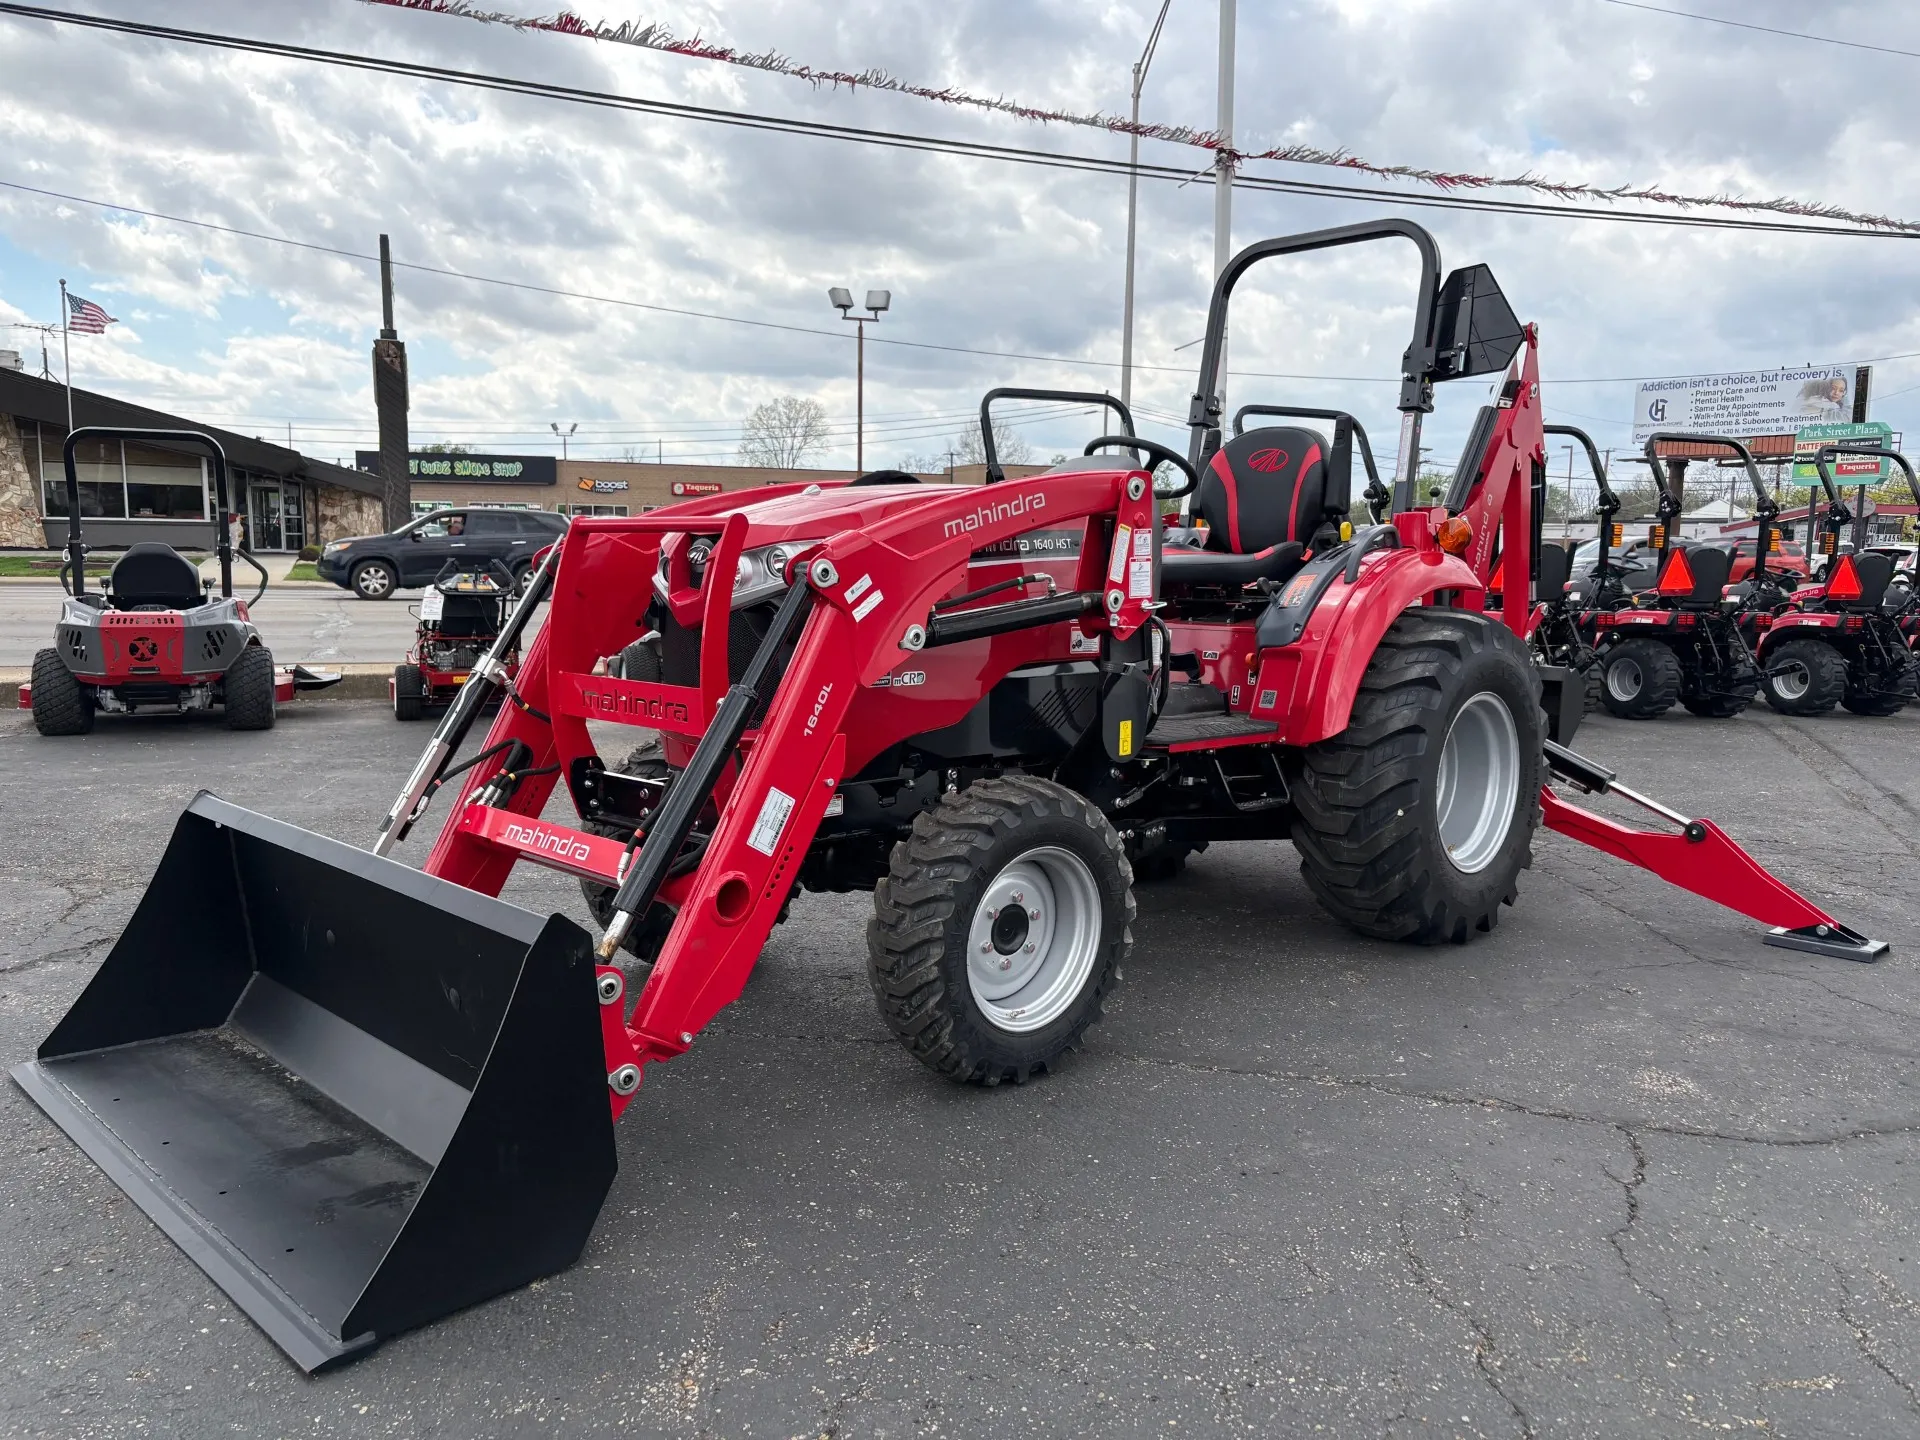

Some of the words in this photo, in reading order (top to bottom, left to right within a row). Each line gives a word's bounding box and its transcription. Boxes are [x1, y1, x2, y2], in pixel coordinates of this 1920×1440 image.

[1641, 380, 1687, 392] Addiction
[1689, 378, 1711, 388] isn't
[1721, 374, 1758, 385] choice,
[1761, 373, 1779, 383] but
[1781, 369, 1830, 381] recovery
[1832, 367, 1845, 377] is.
[1695, 389, 1724, 397] Primary
[1744, 386, 1759, 394] and
[1760, 384, 1777, 392] GYN
[1694, 396, 1719, 405] Mental
[1720, 395, 1745, 403] Health
[1694, 405, 1715, 413] Same
[1716, 403, 1732, 412] Day
[1731, 401, 1785, 411] Appointments
[1692, 419, 1733, 428] Methadone
[1742, 416, 1780, 425] Suboxone
[1781, 414, 1823, 424] Treatment
[1693, 412, 1725, 420] Walk-Ins
[1729, 410, 1760, 418] Available
[1804, 428, 1823, 438] Park
[1826, 426, 1851, 436] Street
[1855, 425, 1879, 434] Plaza
[492, 462, 523, 477] SHOP
[595, 479, 628, 489] boost
[943, 492, 1046, 538] mahindra
[1033, 538, 1054, 550] 1640
[1055, 538, 1072, 549] HST
[582, 689, 689, 723] mahindra
[803, 683, 833, 737] 1640L
[504, 823, 591, 861] mahindra
